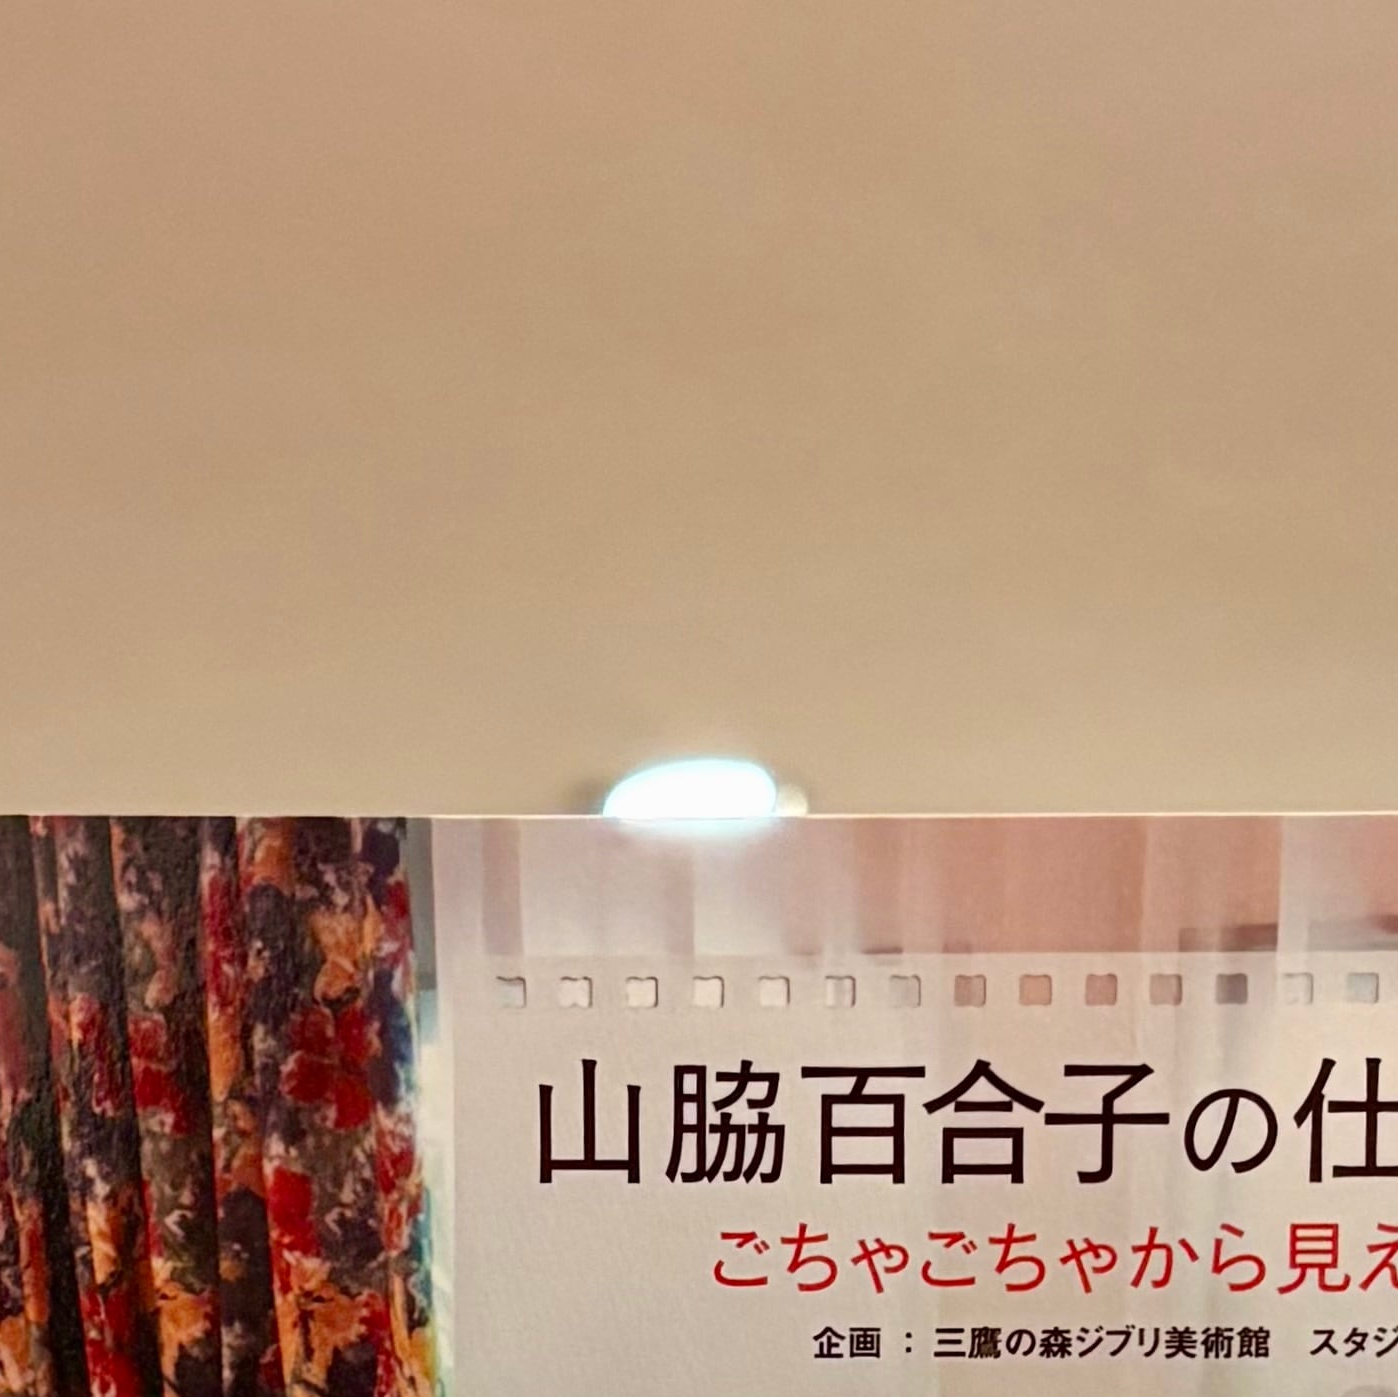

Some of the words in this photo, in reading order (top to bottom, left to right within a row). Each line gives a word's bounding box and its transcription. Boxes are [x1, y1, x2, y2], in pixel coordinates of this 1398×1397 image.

[813, 1326, 883, 1360] 企画
[933, 1325, 1272, 1361] 三鷹の森ジブリ美術館
